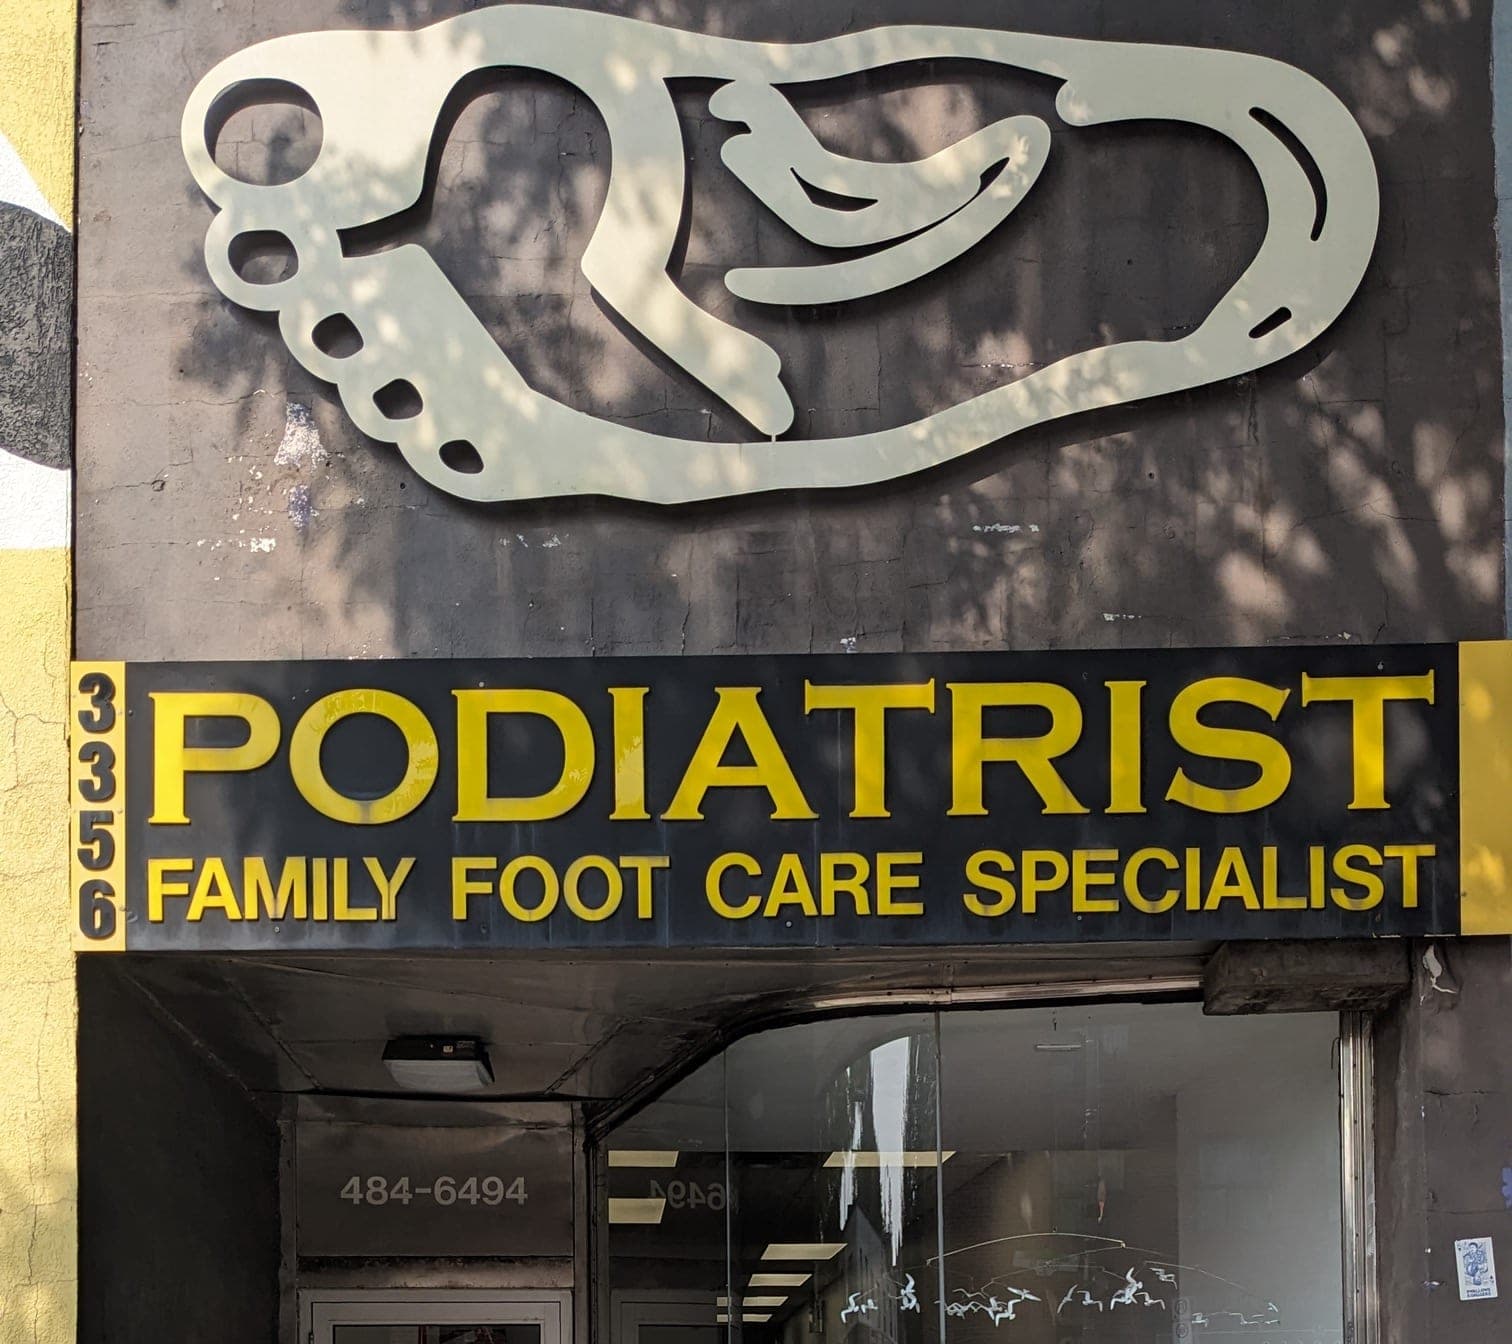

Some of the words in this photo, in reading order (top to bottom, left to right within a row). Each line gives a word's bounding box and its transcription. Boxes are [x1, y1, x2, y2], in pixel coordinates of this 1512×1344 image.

[147, 669, 1435, 825] PODIATRIST
[77, 672, 116, 941] 3356
[147, 856, 416, 923] FAMILY
[452, 854, 671, 922] FOOT
[705, 850, 925, 920] CARE
[963, 843, 1437, 917] SPECIALIST
[339, 1175, 529, 1206] 484-6494
